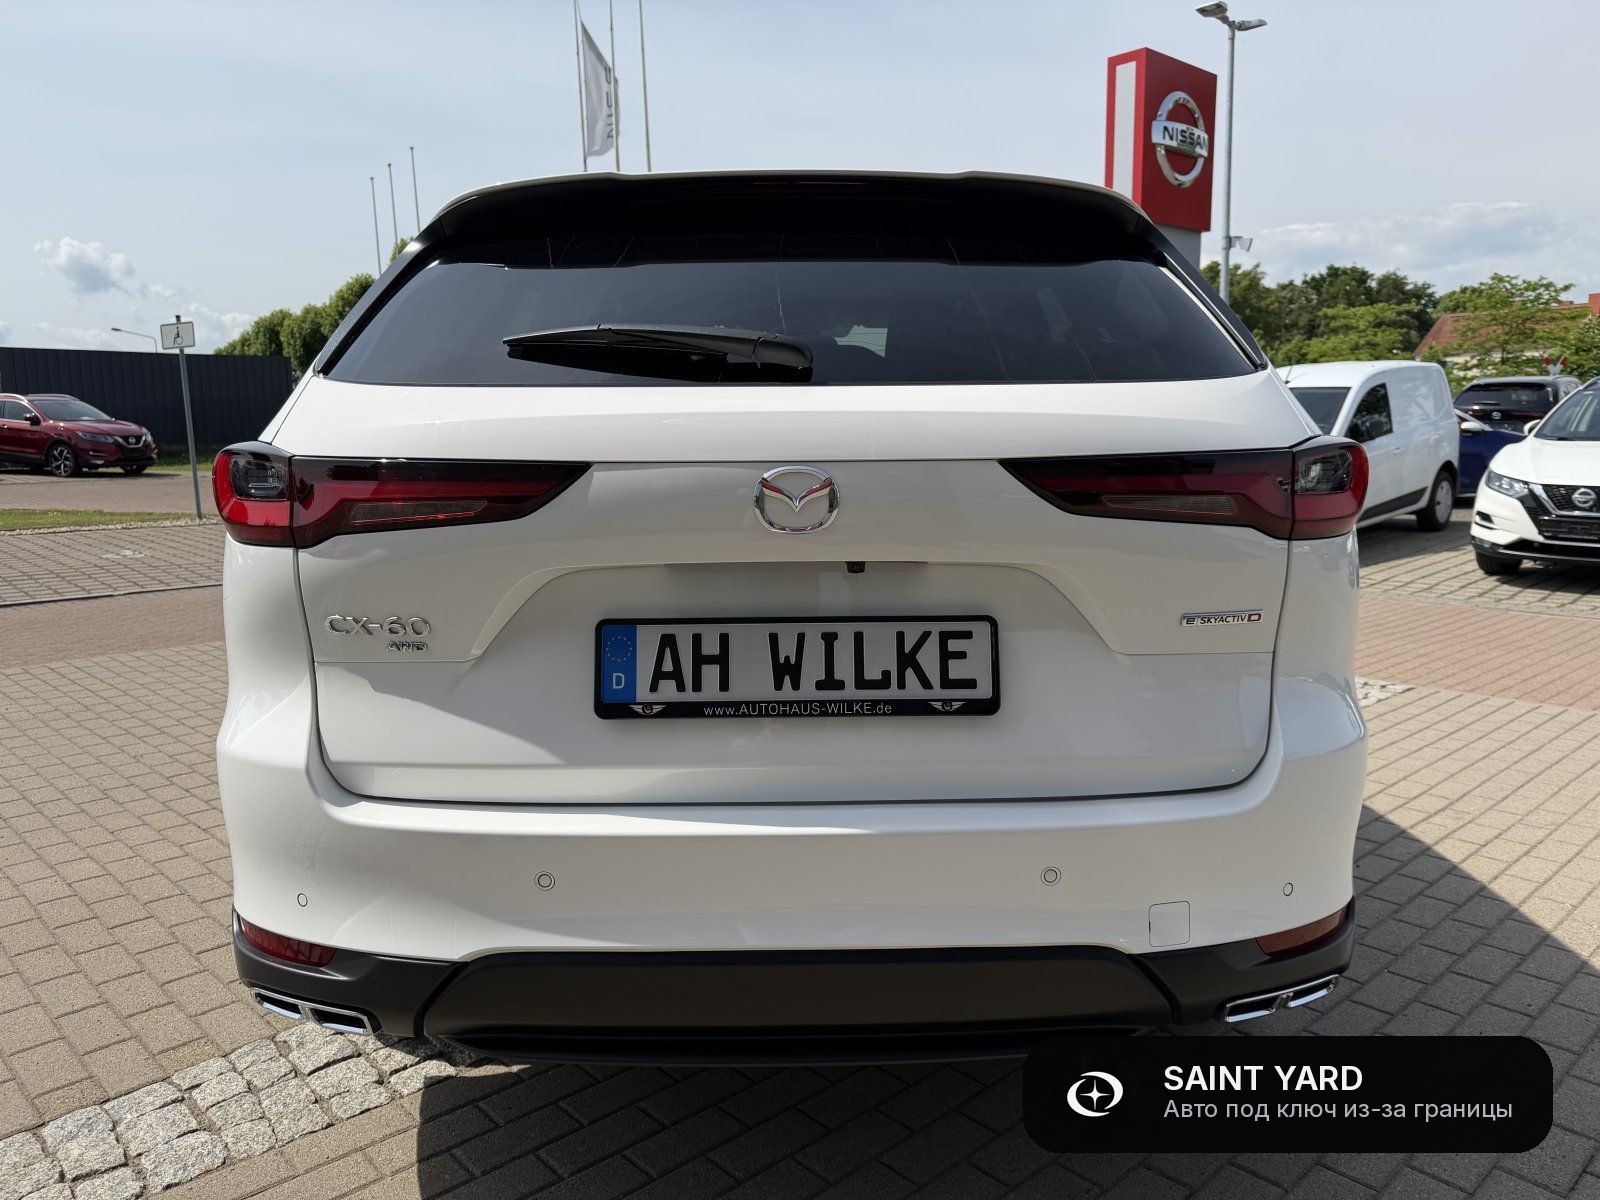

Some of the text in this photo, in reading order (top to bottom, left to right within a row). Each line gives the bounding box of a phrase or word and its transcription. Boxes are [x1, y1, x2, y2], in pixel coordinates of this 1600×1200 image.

[1162, 125, 1208, 150] NISSAN
[325, 614, 431, 638] CX-60
[386, 640, 428, 653] AWD
[648, 629, 978, 693] AH WILKE
[612, 672, 625, 690] D
[703, 701, 892, 717] www.AUTOHAUS-WILKE.de
